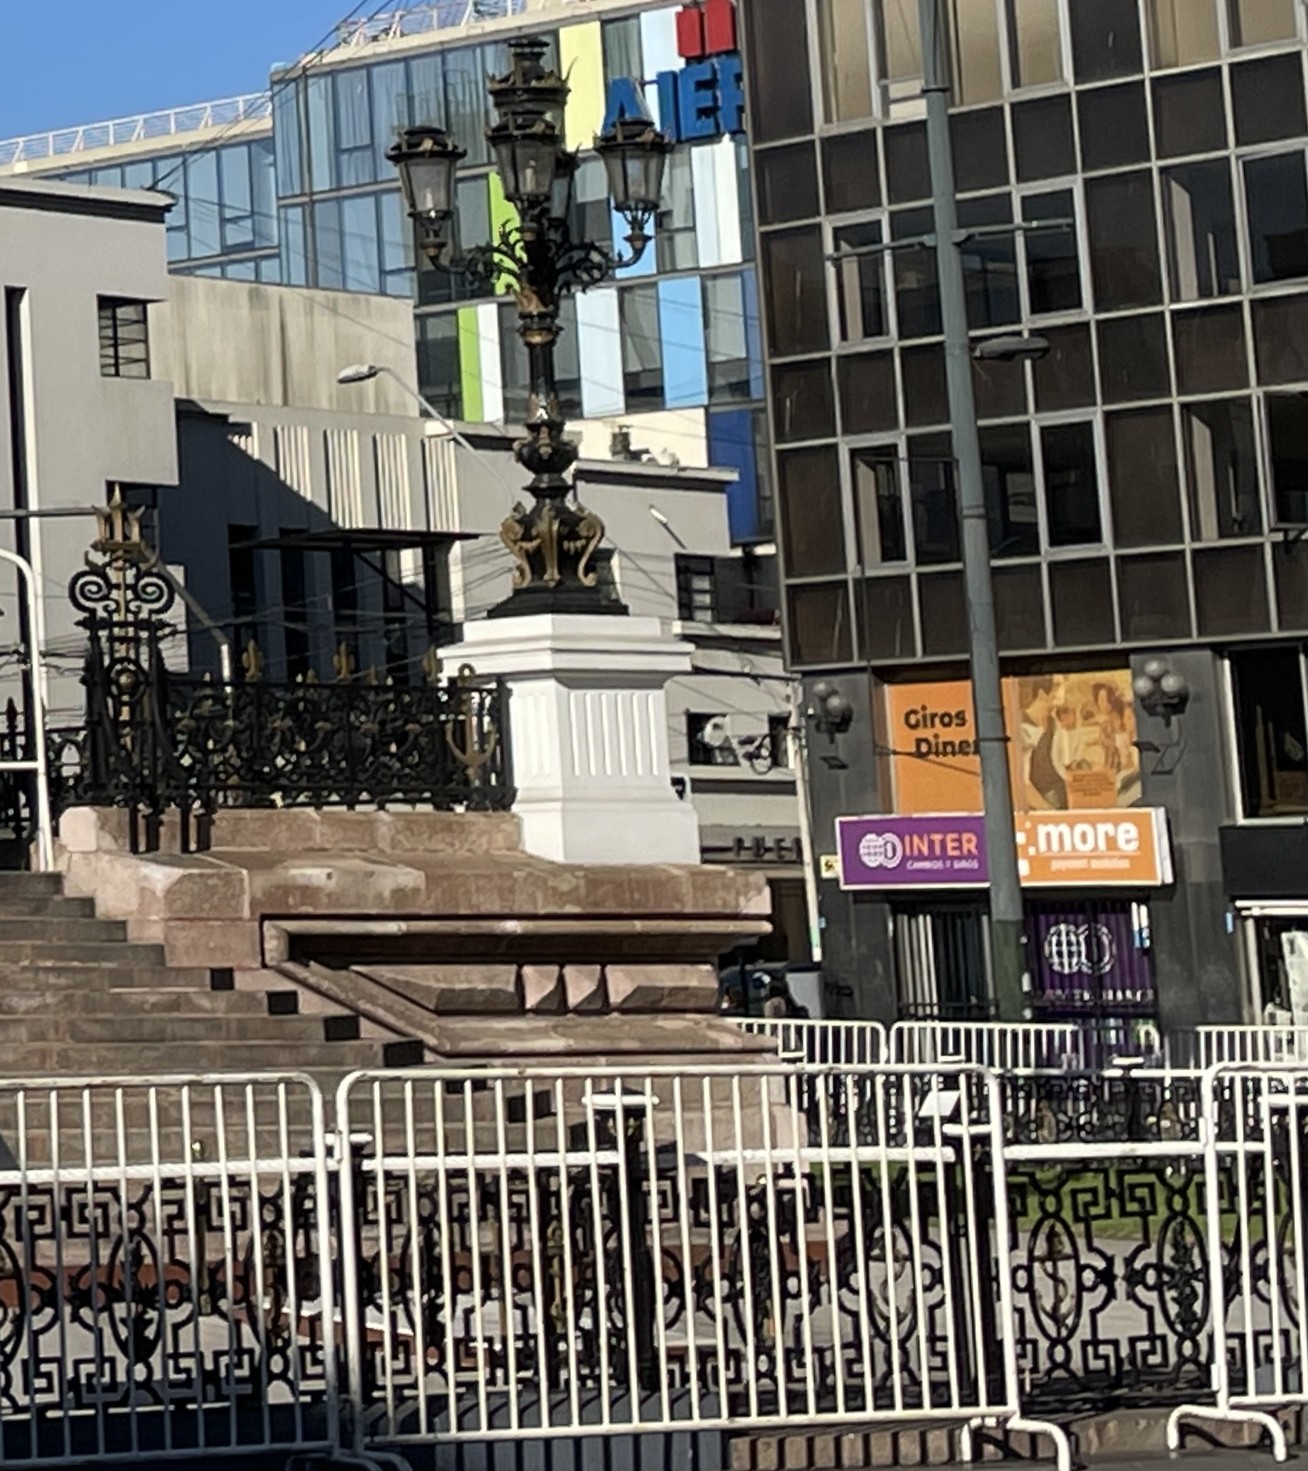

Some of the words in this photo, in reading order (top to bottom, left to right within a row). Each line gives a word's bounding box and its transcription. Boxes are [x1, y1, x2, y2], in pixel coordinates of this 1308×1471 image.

[904, 704, 968, 730] Giros
[904, 832, 979, 857] INTER
[1037, 822, 1140, 853] more
